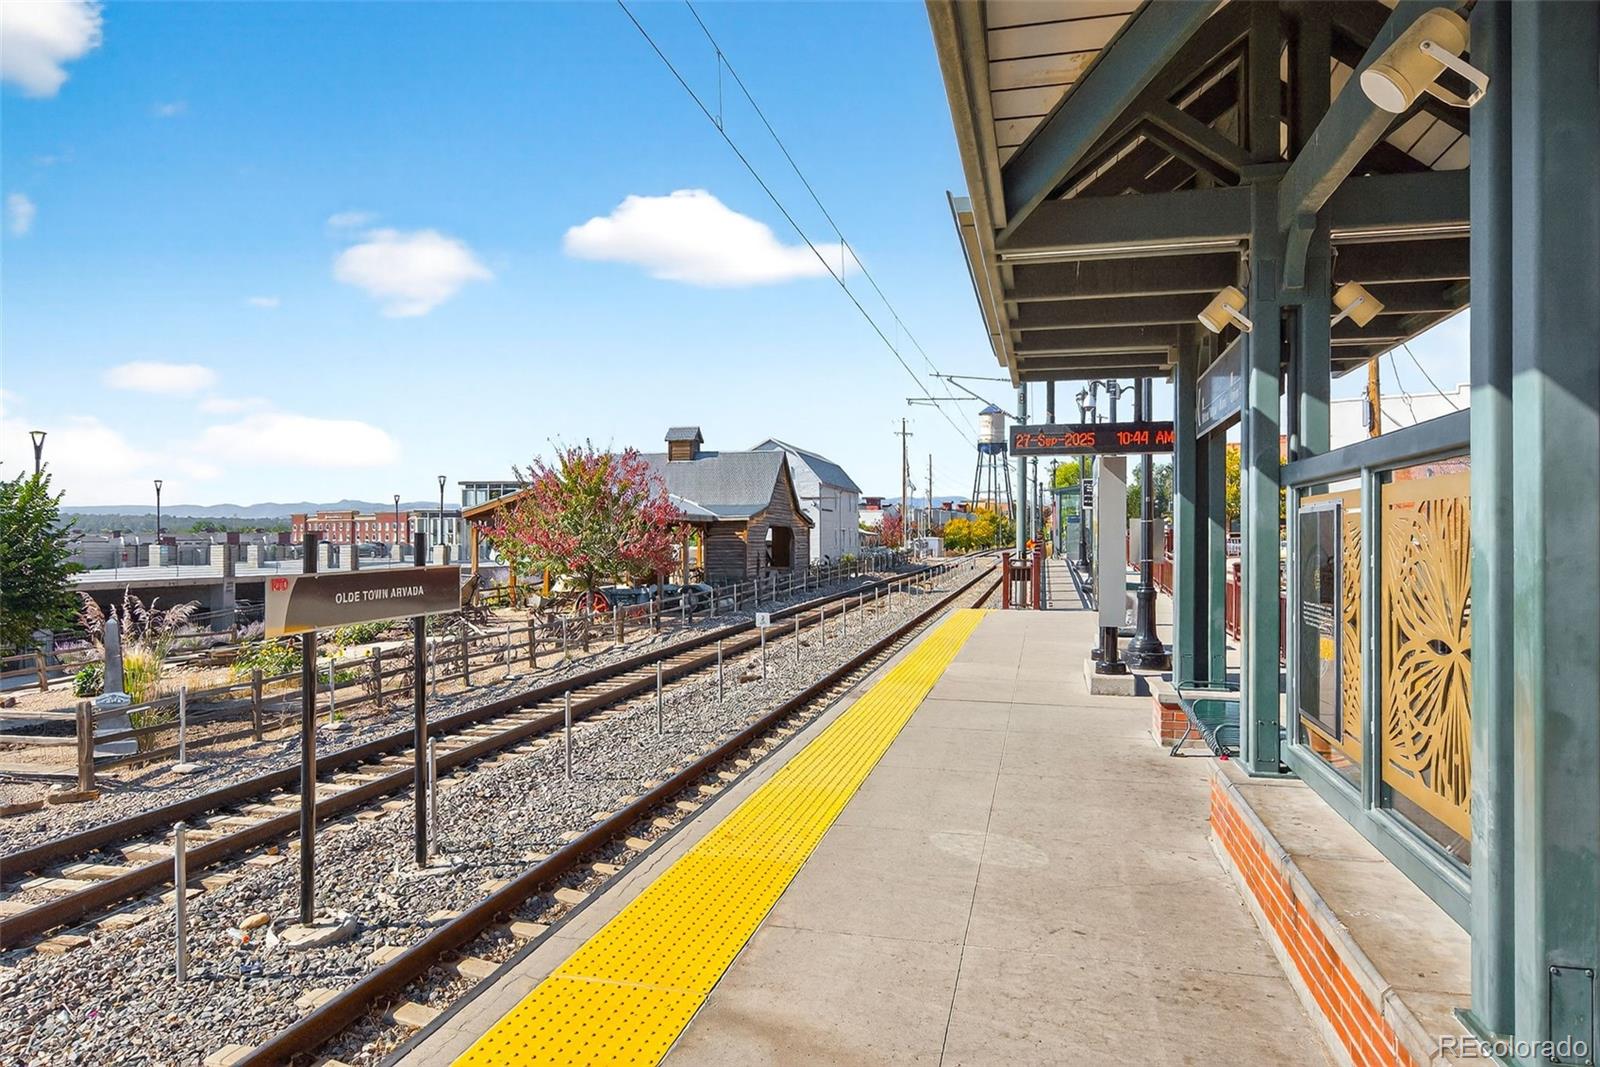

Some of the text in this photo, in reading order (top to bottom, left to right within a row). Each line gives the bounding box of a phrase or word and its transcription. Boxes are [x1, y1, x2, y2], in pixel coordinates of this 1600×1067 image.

[1016, 431, 1175, 448] 27-Sep-2025 10:44 AM
[335, 585, 424, 604] OLDE TOWN ARVADA
